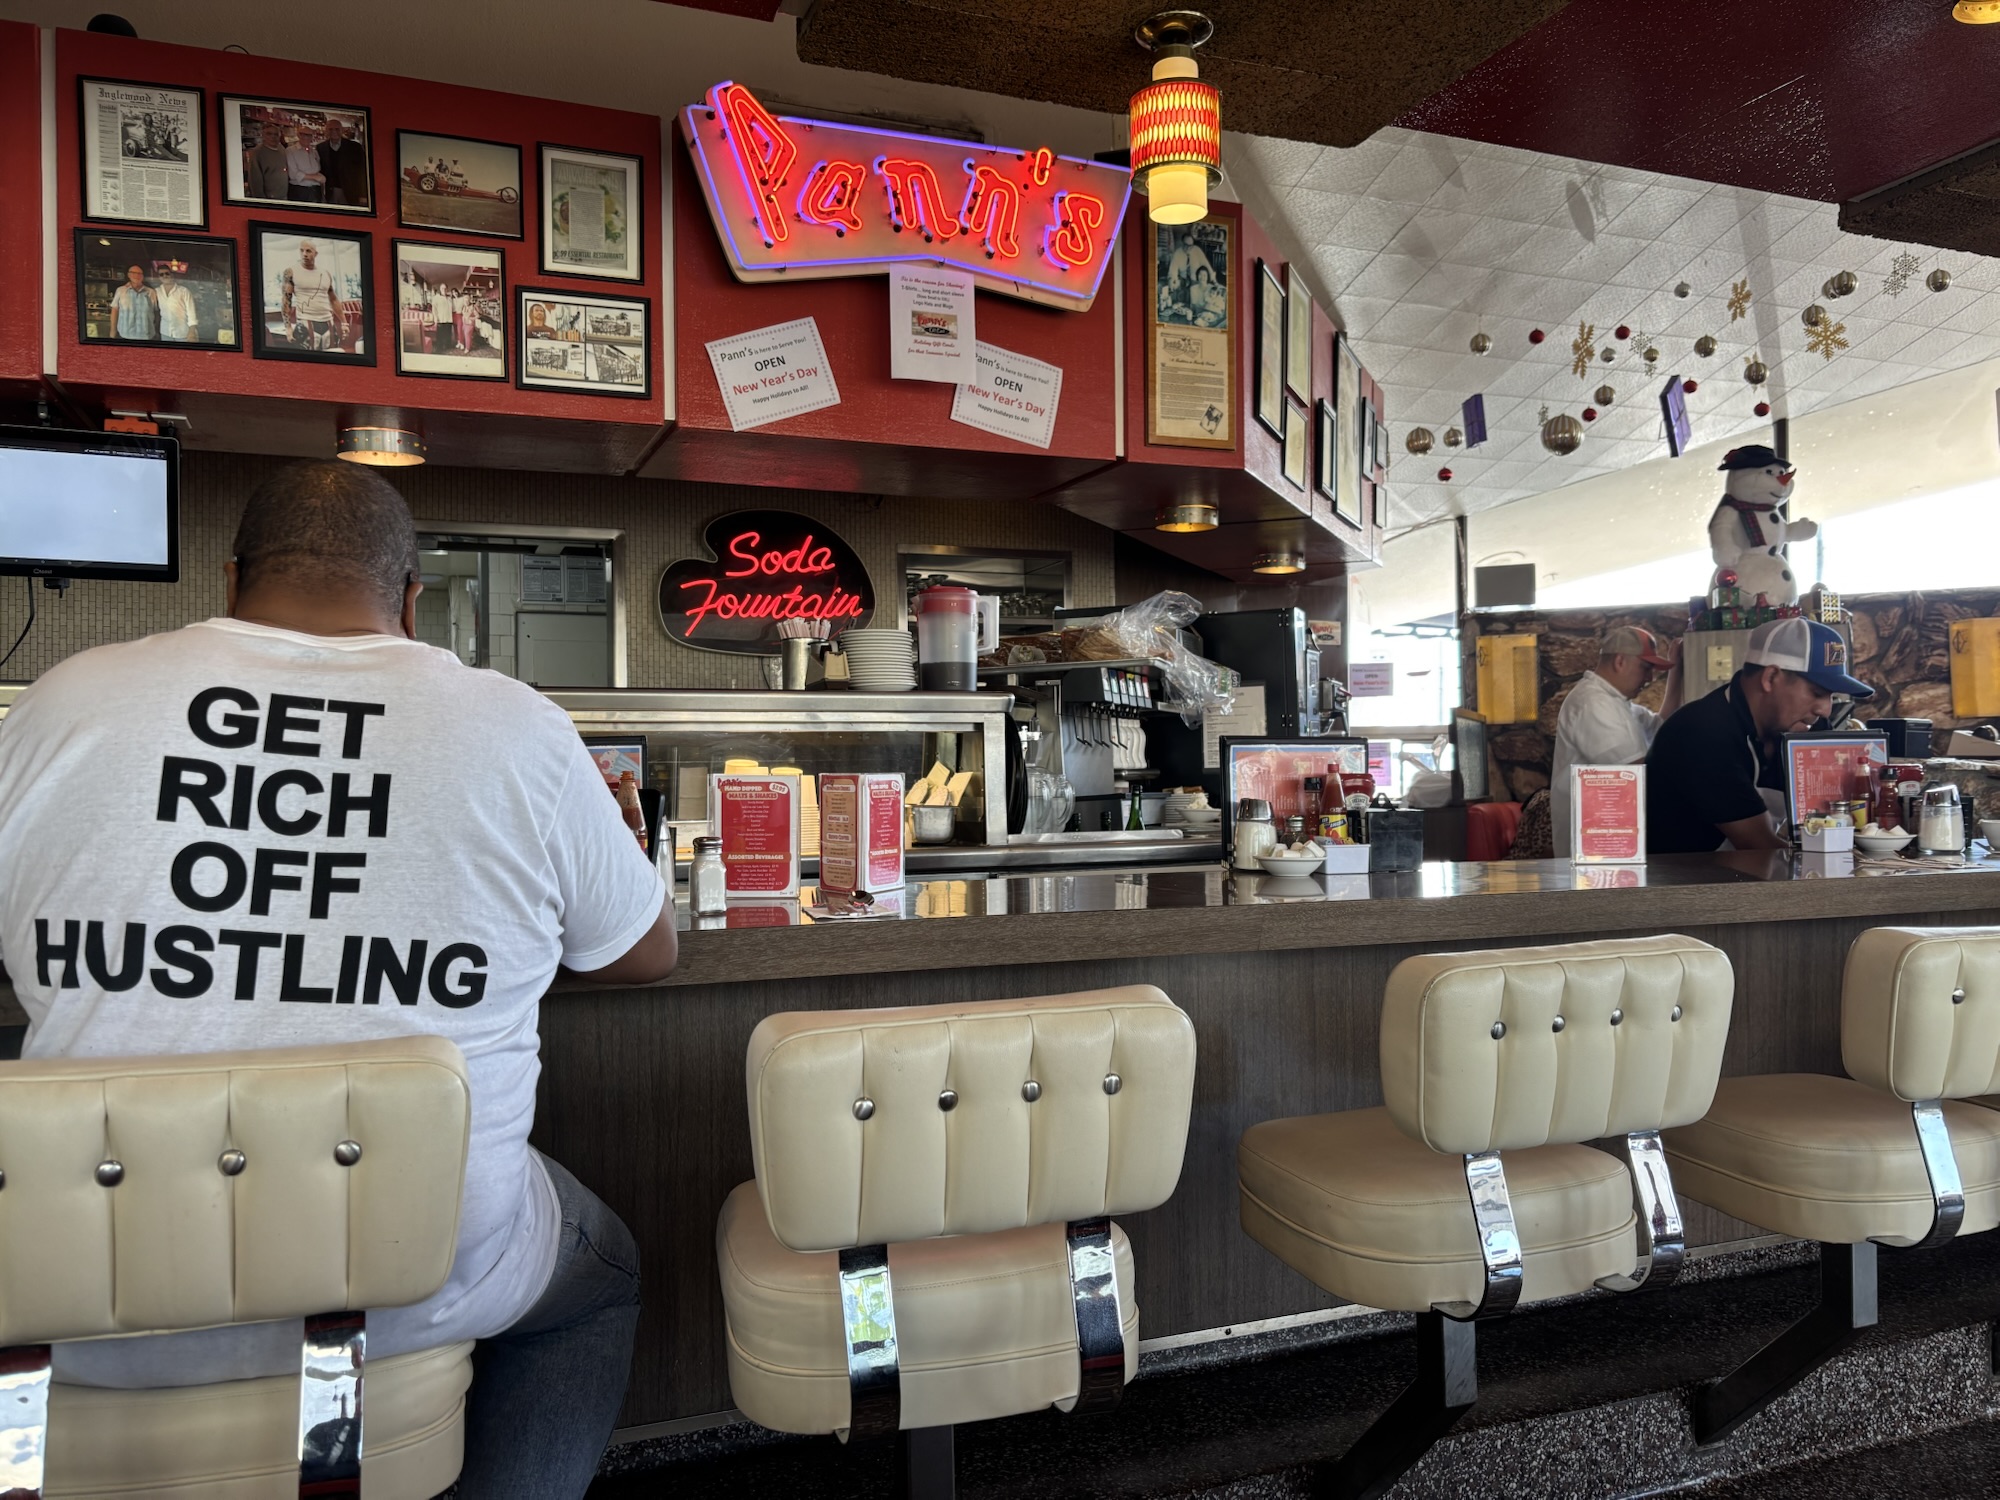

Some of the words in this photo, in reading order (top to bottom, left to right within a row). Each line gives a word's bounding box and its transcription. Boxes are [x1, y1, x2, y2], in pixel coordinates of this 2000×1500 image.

[98, 87, 152, 102] Inglewood
[159, 93, 187, 106] News
[706, 81, 1104, 270] Pann's
[922, 287, 932, 295] long
[720, 346, 754, 362] Pann's
[760, 346, 771, 354] here
[772, 343, 778, 352] to
[778, 340, 794, 349] Serve
[794, 336, 807, 347] You!
[754, 355, 786, 372] OPEN
[733, 381, 759, 396] New
[760, 371, 795, 388] Year's
[796, 366, 818, 379] Day
[994, 376, 1024, 393] OPEN
[1005, 367, 1017, 376] here
[1023, 372, 1037, 382] Serve
[1038, 376, 1050, 385] You!
[752, 395, 770, 405] Happy
[770, 388, 793, 400] Holidays
[967, 384, 991, 399] New
[993, 391, 1023, 410] Year's
[1025, 402, 1046, 417] Day
[977, 403, 993, 413] Happy
[993, 408, 1014, 419] Holidays
[725, 531, 836, 577] Soda
[680, 579, 864, 637] Fountain
[187, 686, 386, 760] GET
[156, 755, 392, 838] RICH
[170, 840, 367, 919] OFF
[35, 918, 489, 1009] HUSTLING
